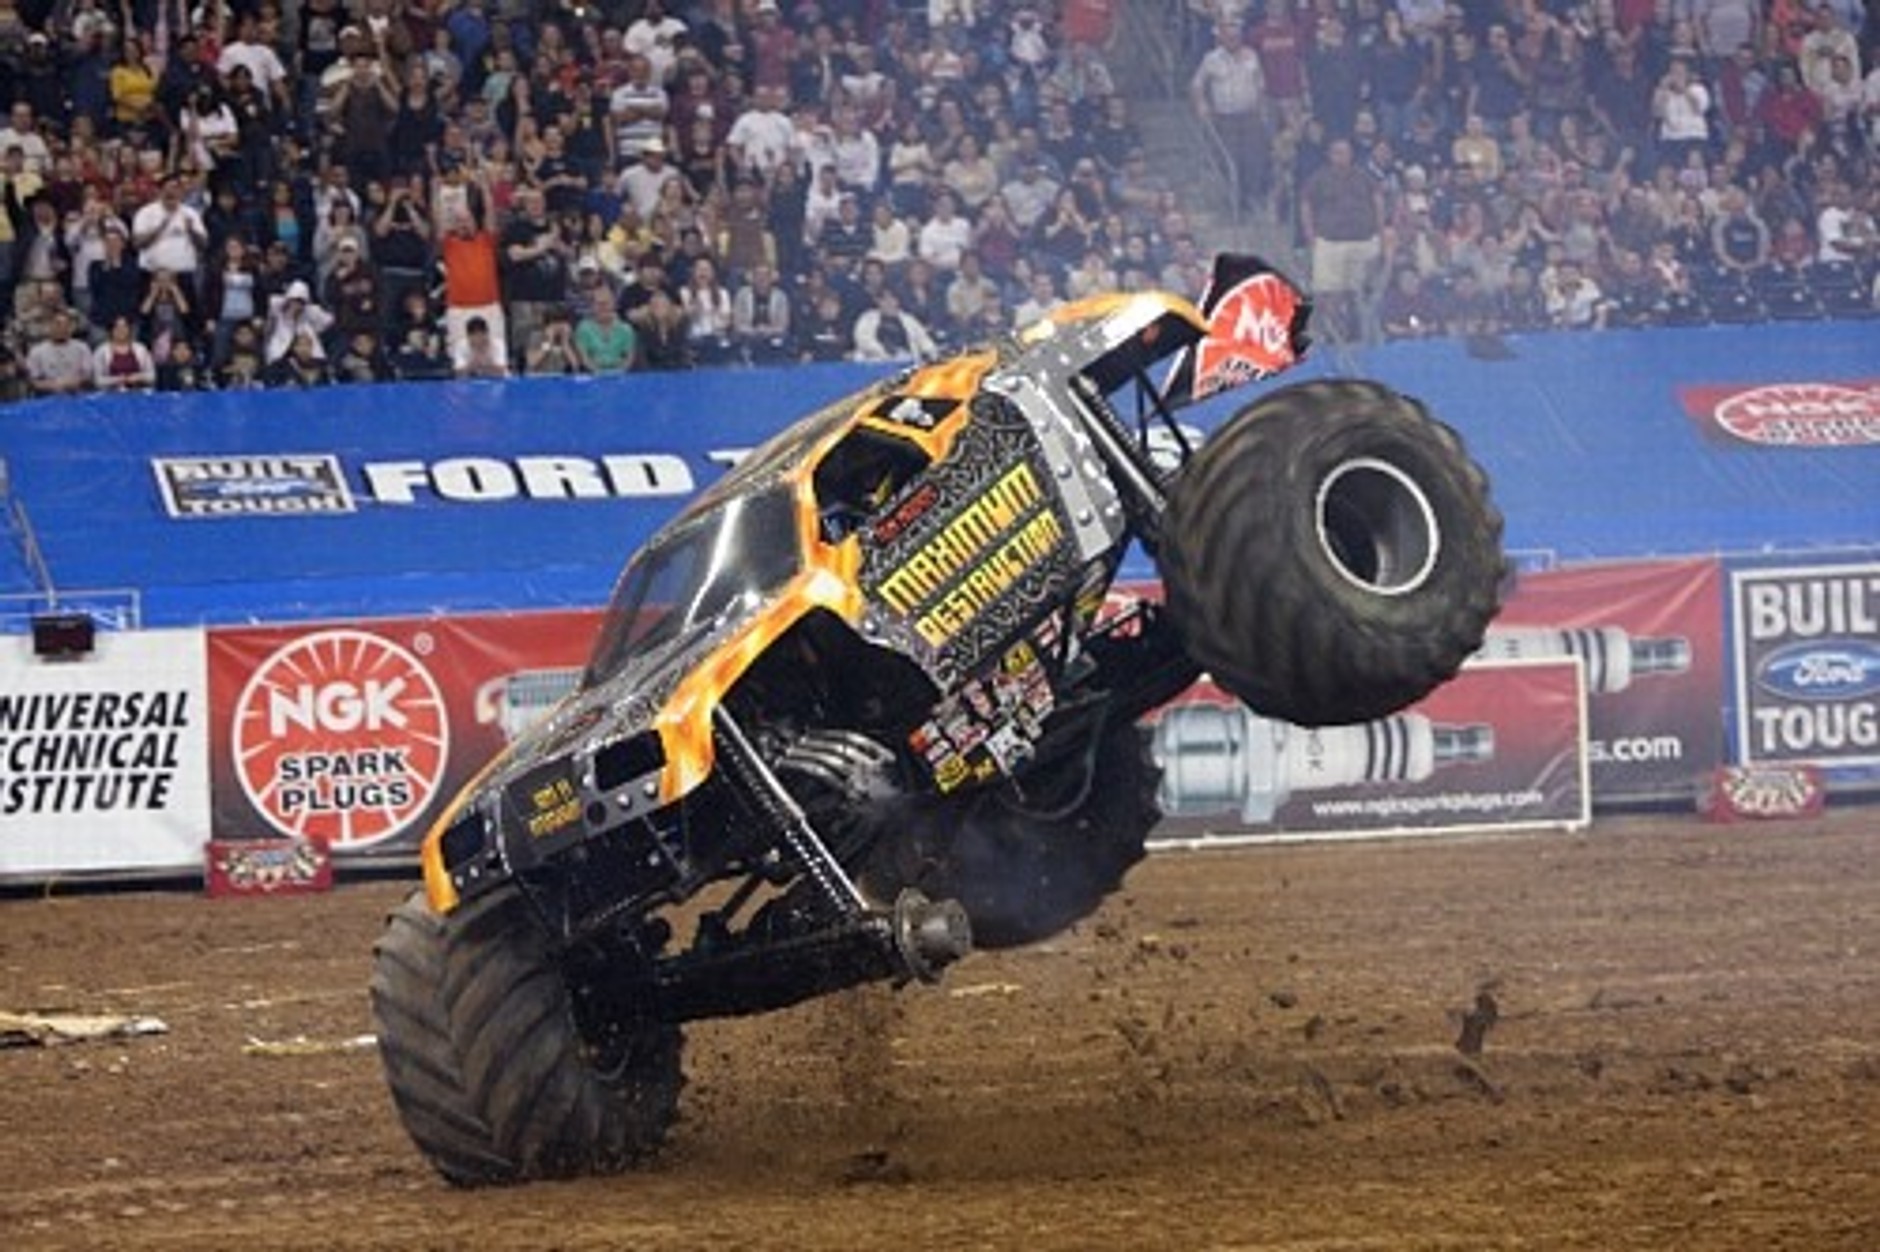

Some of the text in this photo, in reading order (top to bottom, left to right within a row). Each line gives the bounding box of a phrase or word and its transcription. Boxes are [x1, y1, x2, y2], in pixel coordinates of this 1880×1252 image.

[172, 459, 324, 479] BUILT
[365, 454, 696, 503] FORD
[180, 496, 345, 512] TOUGH
[878, 462, 1043, 616] MAXIMUM
[914, 508, 1064, 648] DESTRUCTION
[1793, 653, 1866, 686] Ford
[270, 676, 408, 738] NGK
[0, 733, 178, 771] CHNICAL
[278, 749, 409, 783] SPARK
[279, 781, 410, 812] PLUGS
